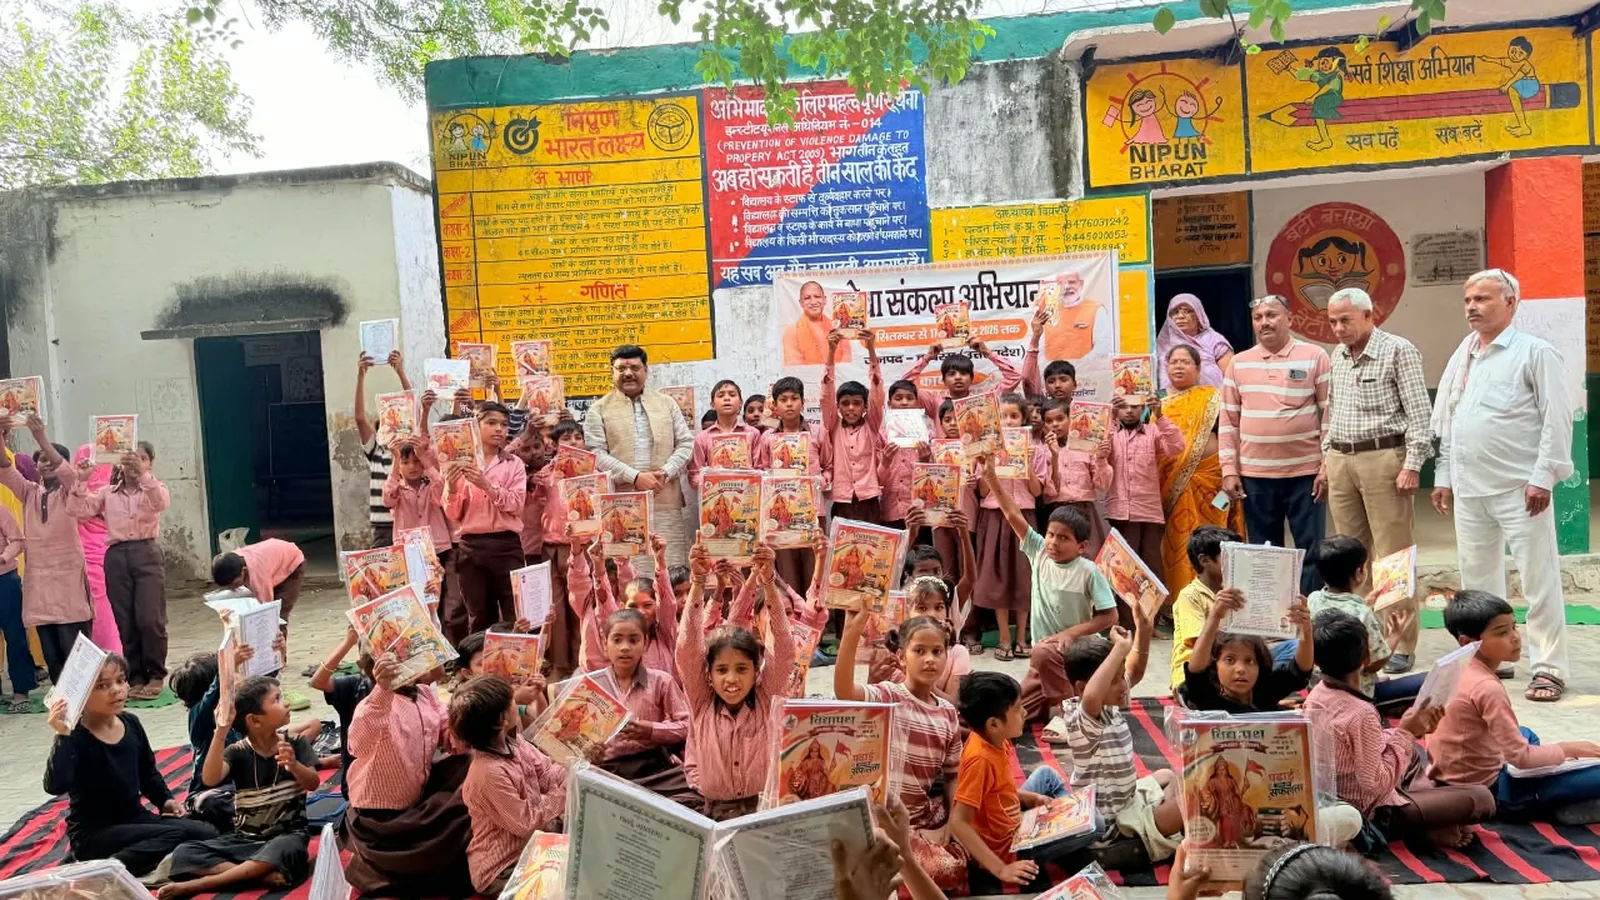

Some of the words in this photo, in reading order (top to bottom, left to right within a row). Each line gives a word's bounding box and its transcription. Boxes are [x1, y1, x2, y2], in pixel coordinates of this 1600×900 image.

[1350, 55, 1372, 86] सर्व
[1377, 53, 1414, 89] शिक्षा
[1418, 46, 1476, 81] अभियान
[564, 106, 618, 134] निपुण
[785, 139, 796, 148] OF
[800, 134, 844, 146] VIOLENCE
[849, 131, 892, 143] DAMAGE
[896, 130, 910, 140] TO
[1347, 134, 1373, 151] सब
[1436, 127, 1458, 142] सब
[544, 138, 595, 159] भारत
[597, 132, 645, 158] लक्ष्य
[1130, 142, 1206, 164] NIPUN
[449, 152, 486, 160] NIPUN
[449, 160, 488, 168] BHARAT
[777, 150, 796, 161] ACT
[556, 170, 591, 186] भाषा
[712, 168, 738, 192] अब
[816, 158, 841, 184] तीन
[841, 161, 874, 184] साल
[1130, 162, 1207, 180] BHARAT
[740, 194, 774, 206] विद्यालय
[720, 266, 740, 284] यह
[740, 266, 764, 282] सब
[580, 280, 629, 300] गणित
[959, 270, 1040, 310] अभियान
[876, 328, 916, 342] सितम्बर
[918, 328, 928, 340] से
[1000, 324, 1020, 333] तक
